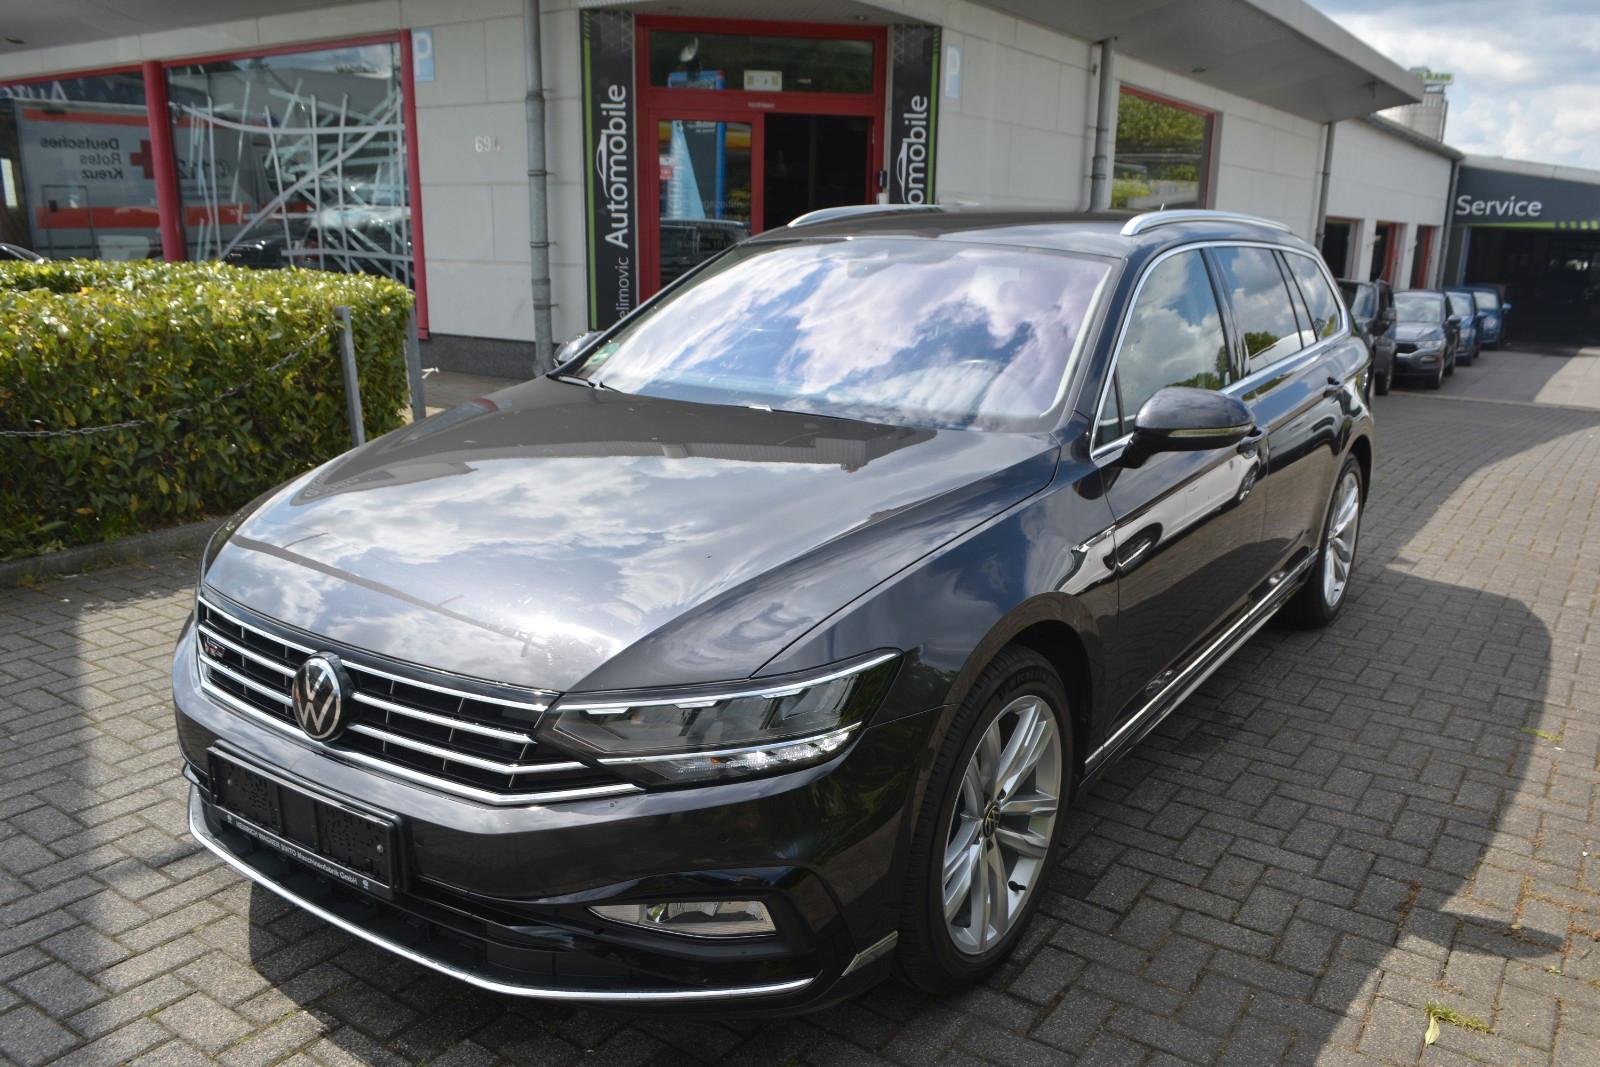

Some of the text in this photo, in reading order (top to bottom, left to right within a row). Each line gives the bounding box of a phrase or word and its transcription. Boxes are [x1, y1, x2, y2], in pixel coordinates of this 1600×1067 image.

[412, 31, 432, 78] P
[945, 46, 961, 99] P
[902, 95, 928, 204] omobile
[600, 84, 630, 320] elimovic Automobile
[1455, 195, 1543, 217] Service
[340, 871, 358, 885] GmbH
